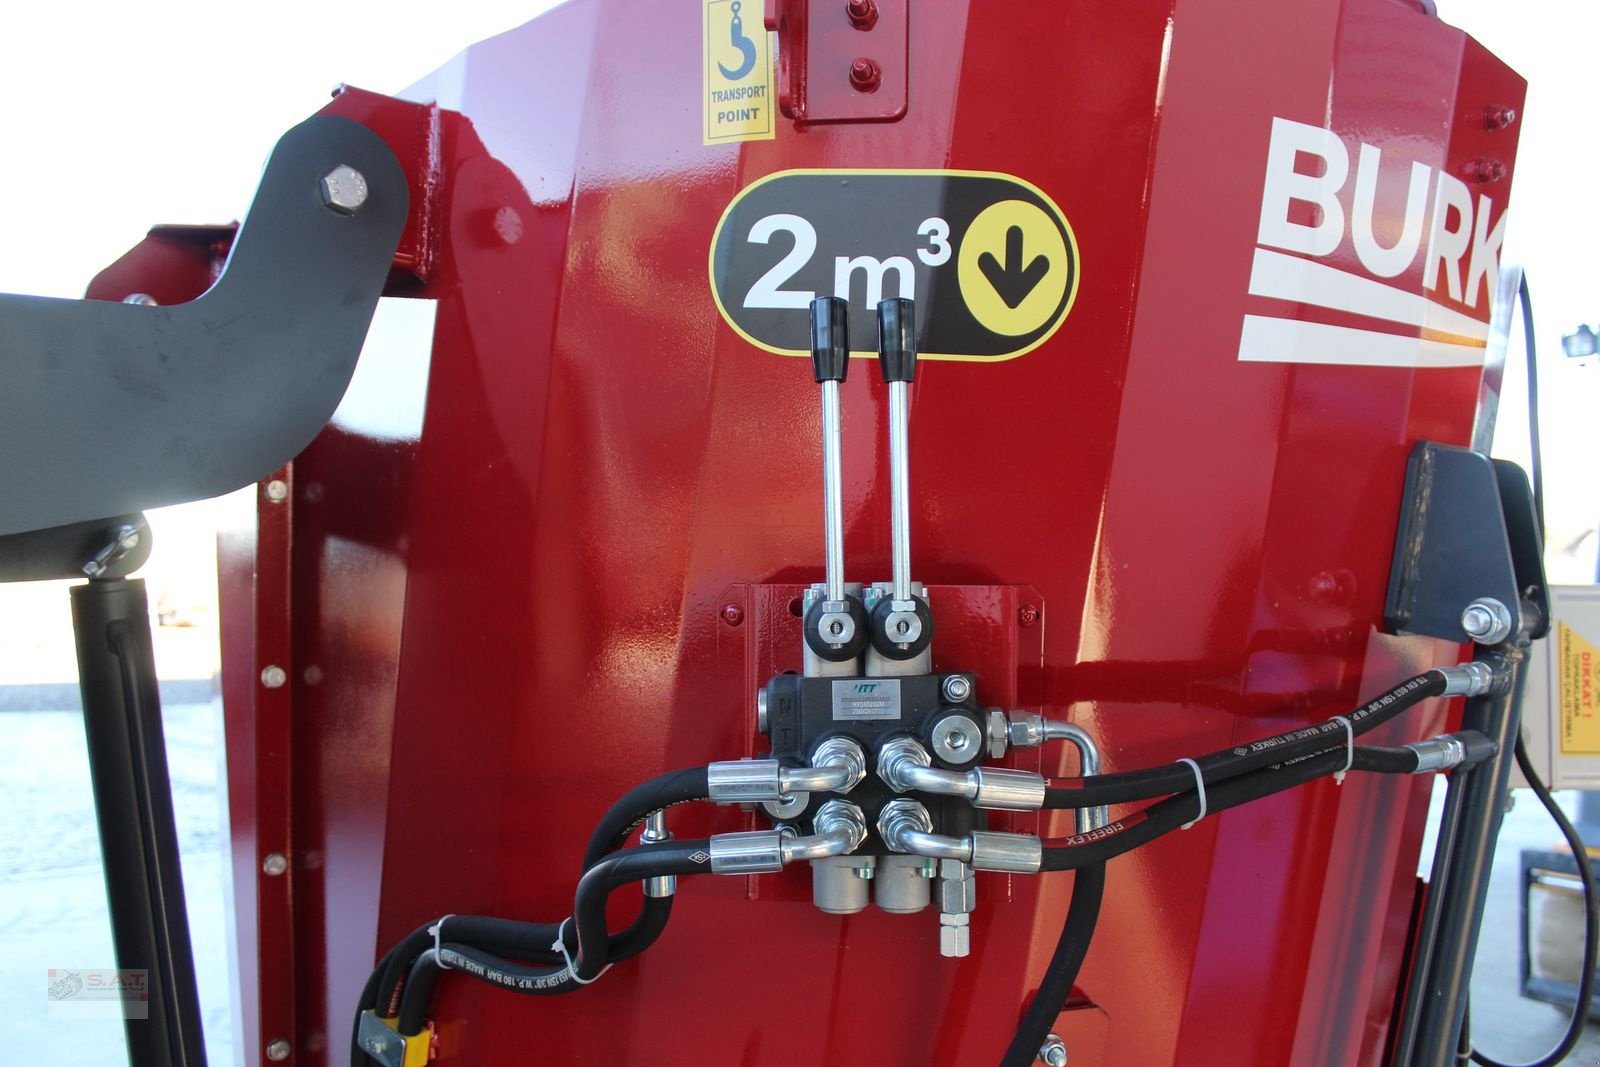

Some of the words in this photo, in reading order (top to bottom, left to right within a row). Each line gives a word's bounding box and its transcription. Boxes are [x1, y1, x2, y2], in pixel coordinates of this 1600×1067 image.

[712, 85, 766, 103] TRANSPORT
[718, 108, 760, 123] POINT
[743, 213, 818, 309] 2
[1295, 728, 1320, 739] MADE
[1320, 721, 1339, 732] BAR
[1250, 737, 1287, 752] TURKEY
[1283, 734, 1296, 742] IN
[1065, 822, 1124, 846] FIREFLEX
[439, 951, 458, 965] TURKE
[465, 959, 484, 976] MADE
[487, 969, 502, 983] BAR
[503, 975, 516, 987] 180
